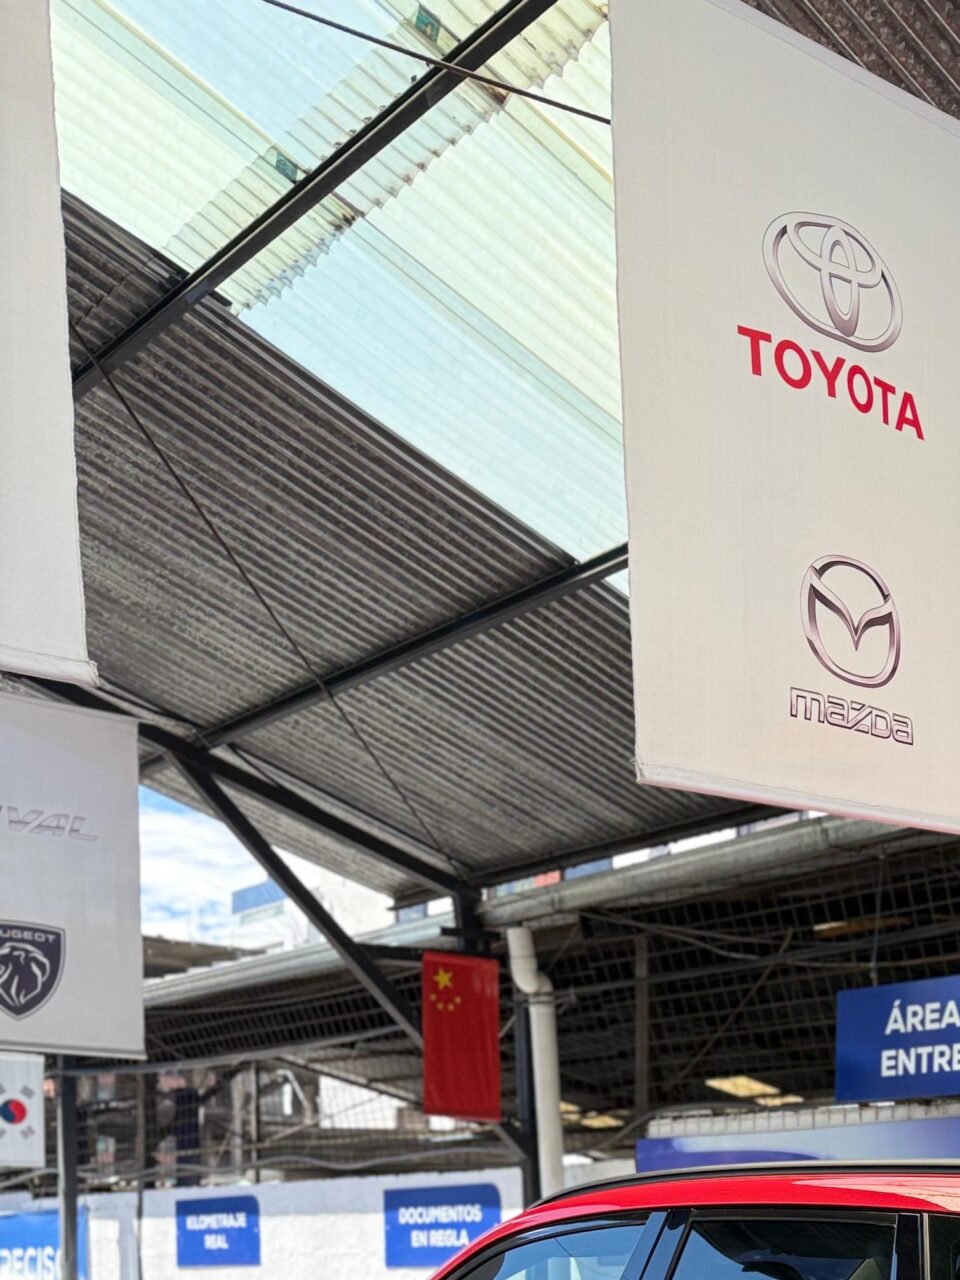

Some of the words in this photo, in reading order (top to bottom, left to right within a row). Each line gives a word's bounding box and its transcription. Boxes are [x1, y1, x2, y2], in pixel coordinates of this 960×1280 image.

[737, 324, 925, 441] TOYOTA
[0, 804, 99, 842] VAL
[398, 1203, 483, 1225] DOCUMENTOS
[204, 1234, 229, 1250] REAL
[411, 1230, 428, 1248] EN
[429, 1228, 470, 1247] REGLA
